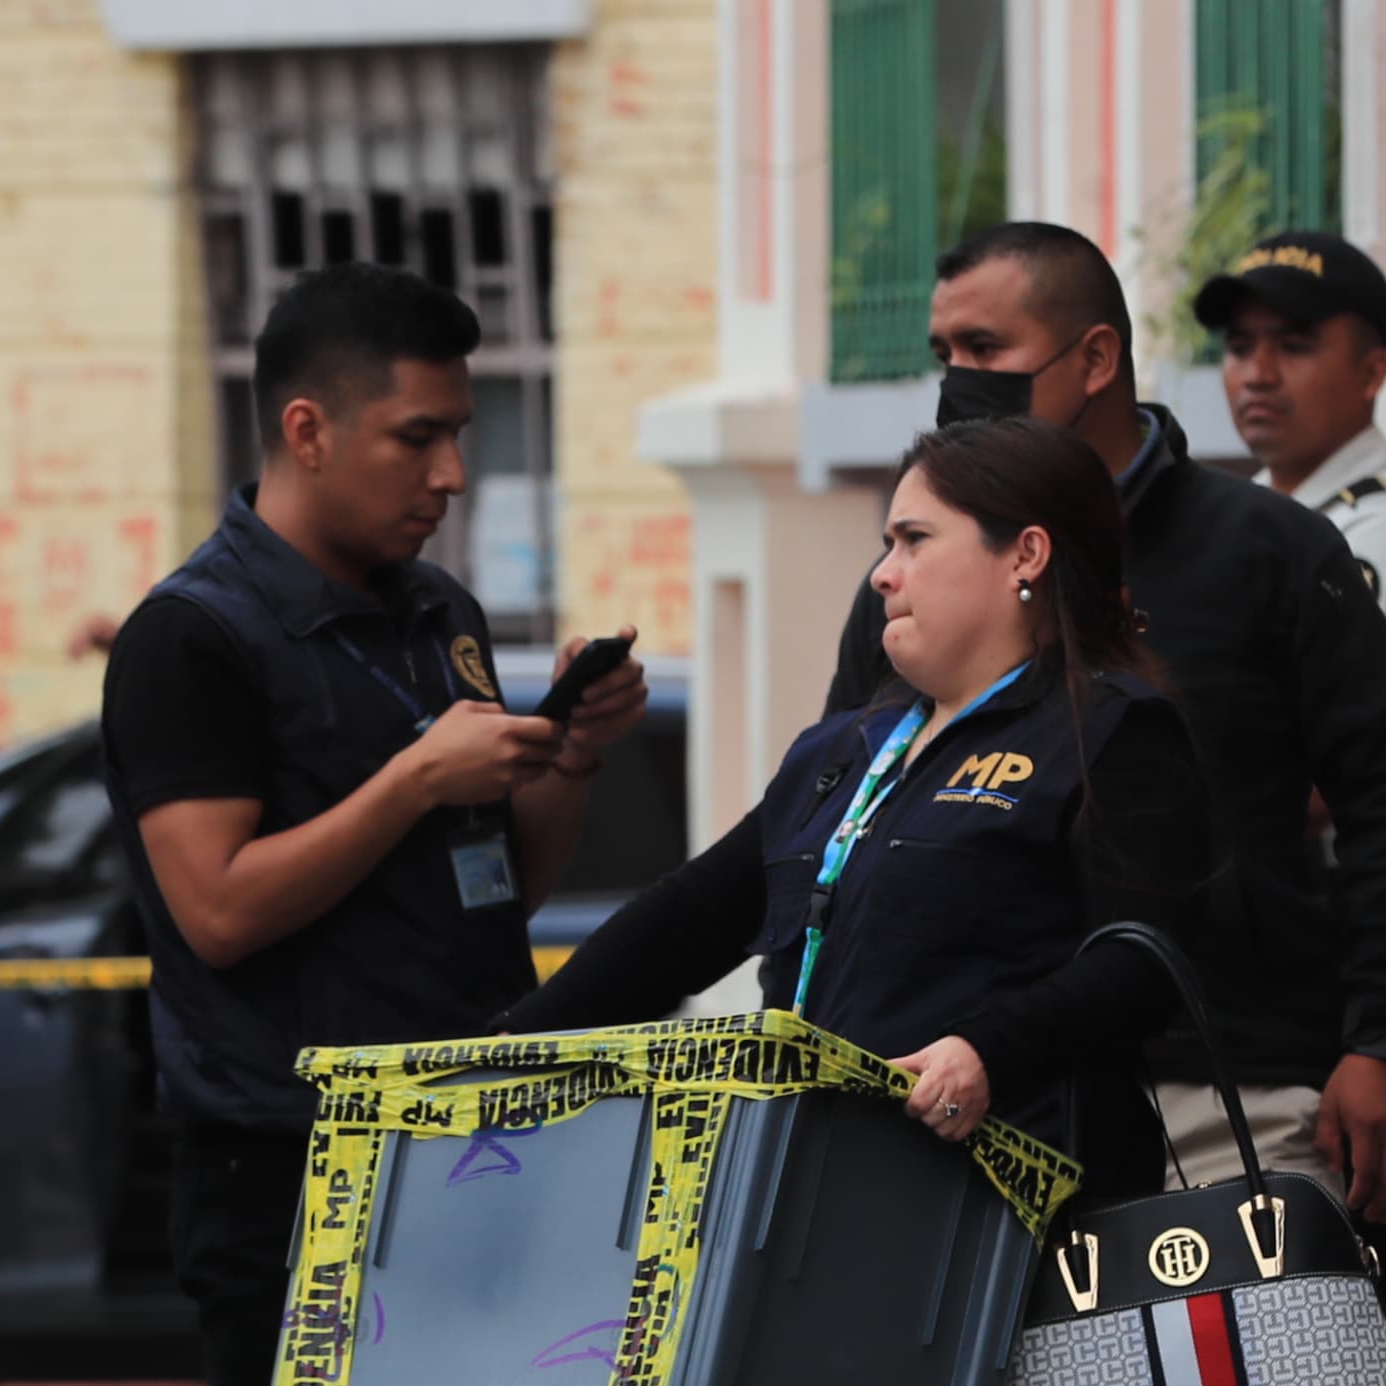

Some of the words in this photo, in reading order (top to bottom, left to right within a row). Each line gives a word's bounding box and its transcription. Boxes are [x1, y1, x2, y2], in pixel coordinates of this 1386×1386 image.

[946, 752, 1034, 790] MP
[647, 1037, 820, 1084] EVIDENCIA
[321, 1168, 353, 1229] MP
